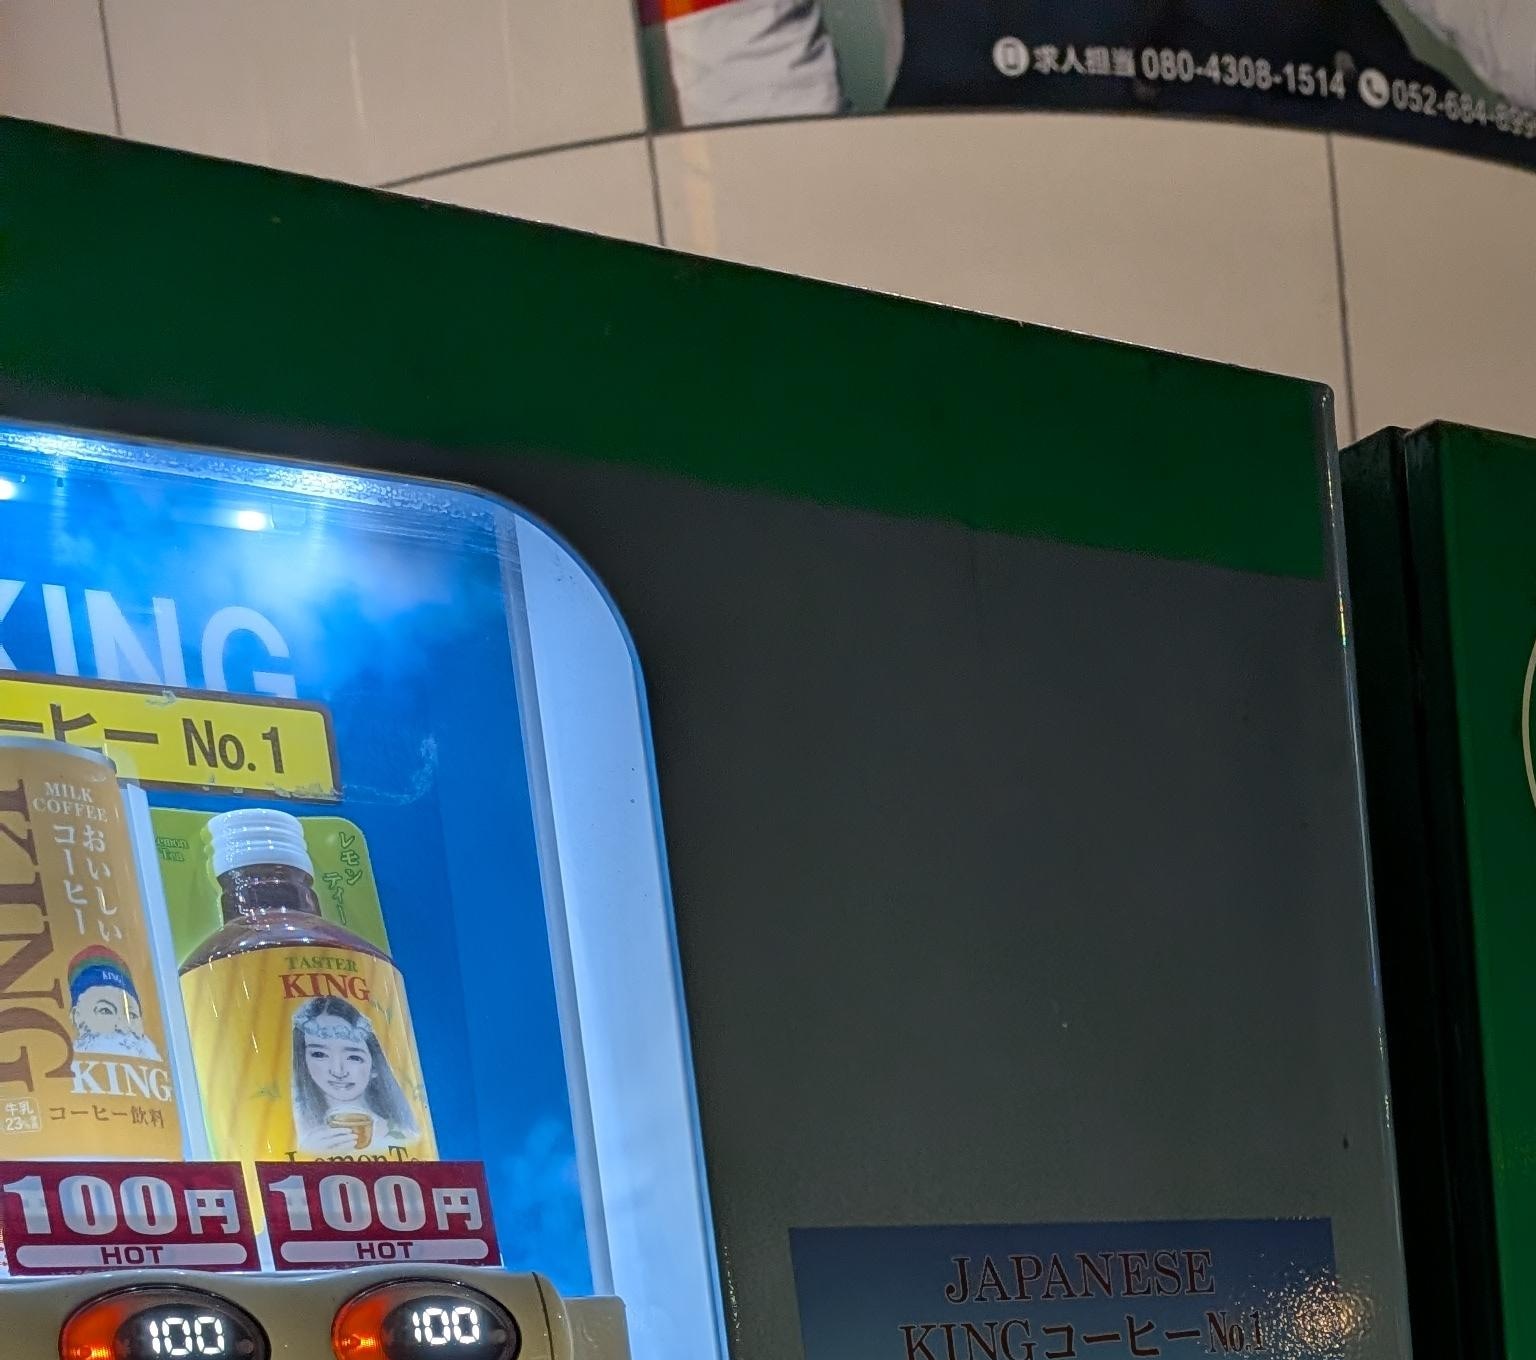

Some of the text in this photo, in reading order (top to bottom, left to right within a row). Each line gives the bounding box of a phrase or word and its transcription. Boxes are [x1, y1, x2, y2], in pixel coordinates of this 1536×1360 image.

[1033, 47, 1346, 100] 求人担当 080-4308-1514
[182, 718, 285, 775] No.1
[32, 799, 110, 823] COFFEE
[44, 782, 93, 802] MILK
[54, 824, 88, 936] コーヒー
[338, 830, 363, 887] レモン
[83, 824, 123, 943] おいしい
[323, 872, 352, 925] ティー
[286, 956, 359, 973] TASTER
[282, 973, 371, 1002] KING
[70, 1059, 172, 1102] KING
[49, 1104, 166, 1129] コーヒー飲料
[3, 1175, 241, 1236] 100円
[269, 1175, 484, 1234] 100円
[101, 1245, 164, 1265] HOT
[356, 1241, 414, 1261] HOT
[944, 1249, 1216, 1304] JAPANESE
[149, 1315, 226, 1357] 100
[412, 1306, 481, 1346] 100
